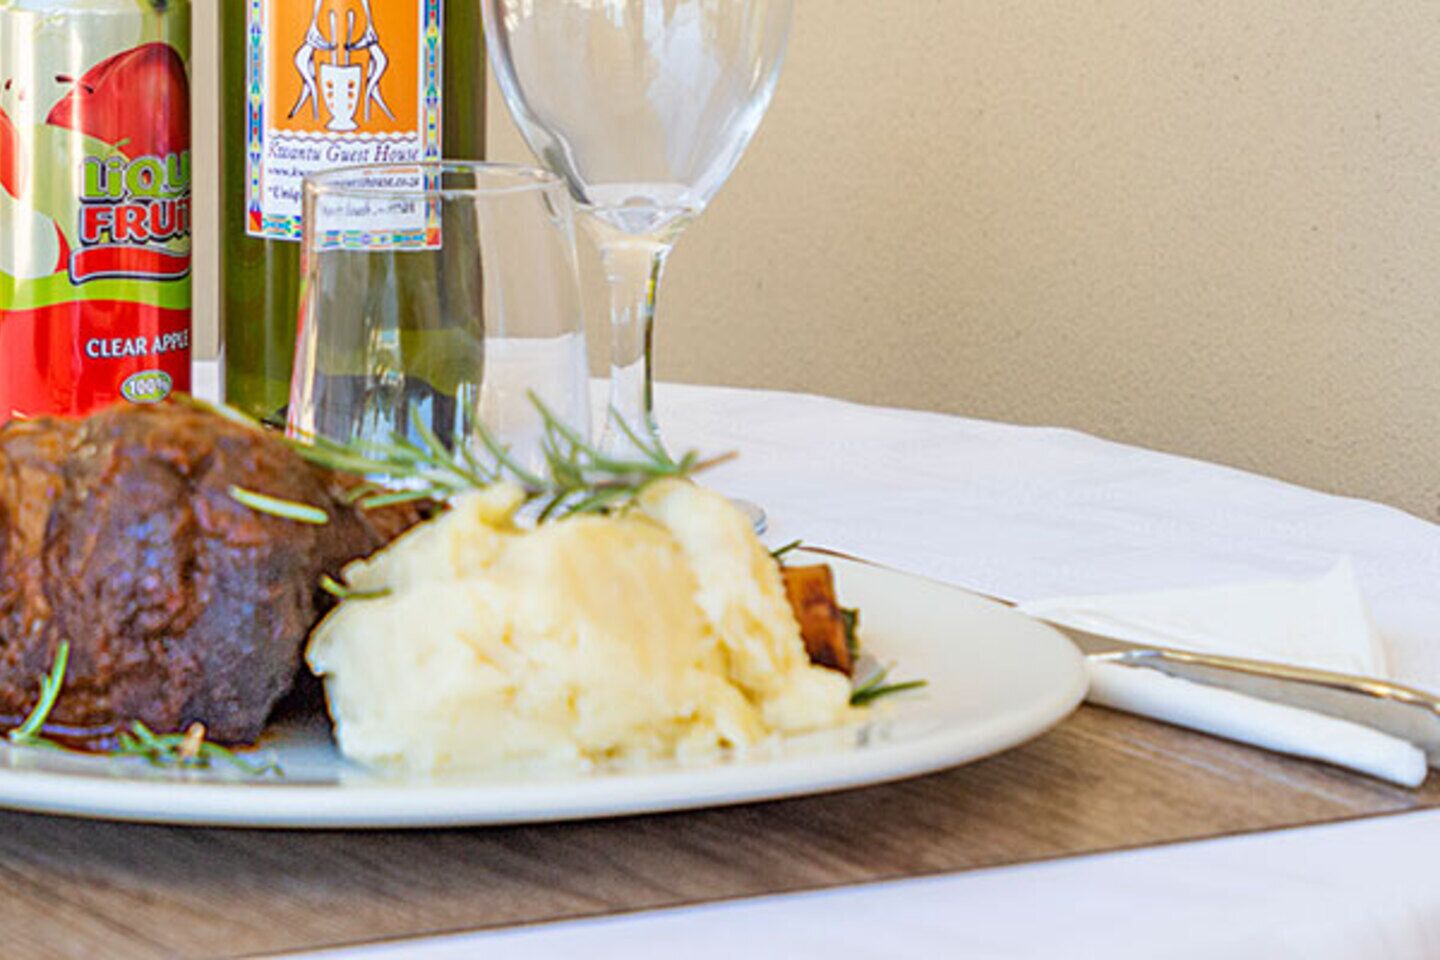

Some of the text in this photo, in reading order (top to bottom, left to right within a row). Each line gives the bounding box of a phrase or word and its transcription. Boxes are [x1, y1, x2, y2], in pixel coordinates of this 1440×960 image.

[326, 144, 370, 162] Guest
[373, 144, 420, 163] House
[85, 337, 148, 358] CLEAR
